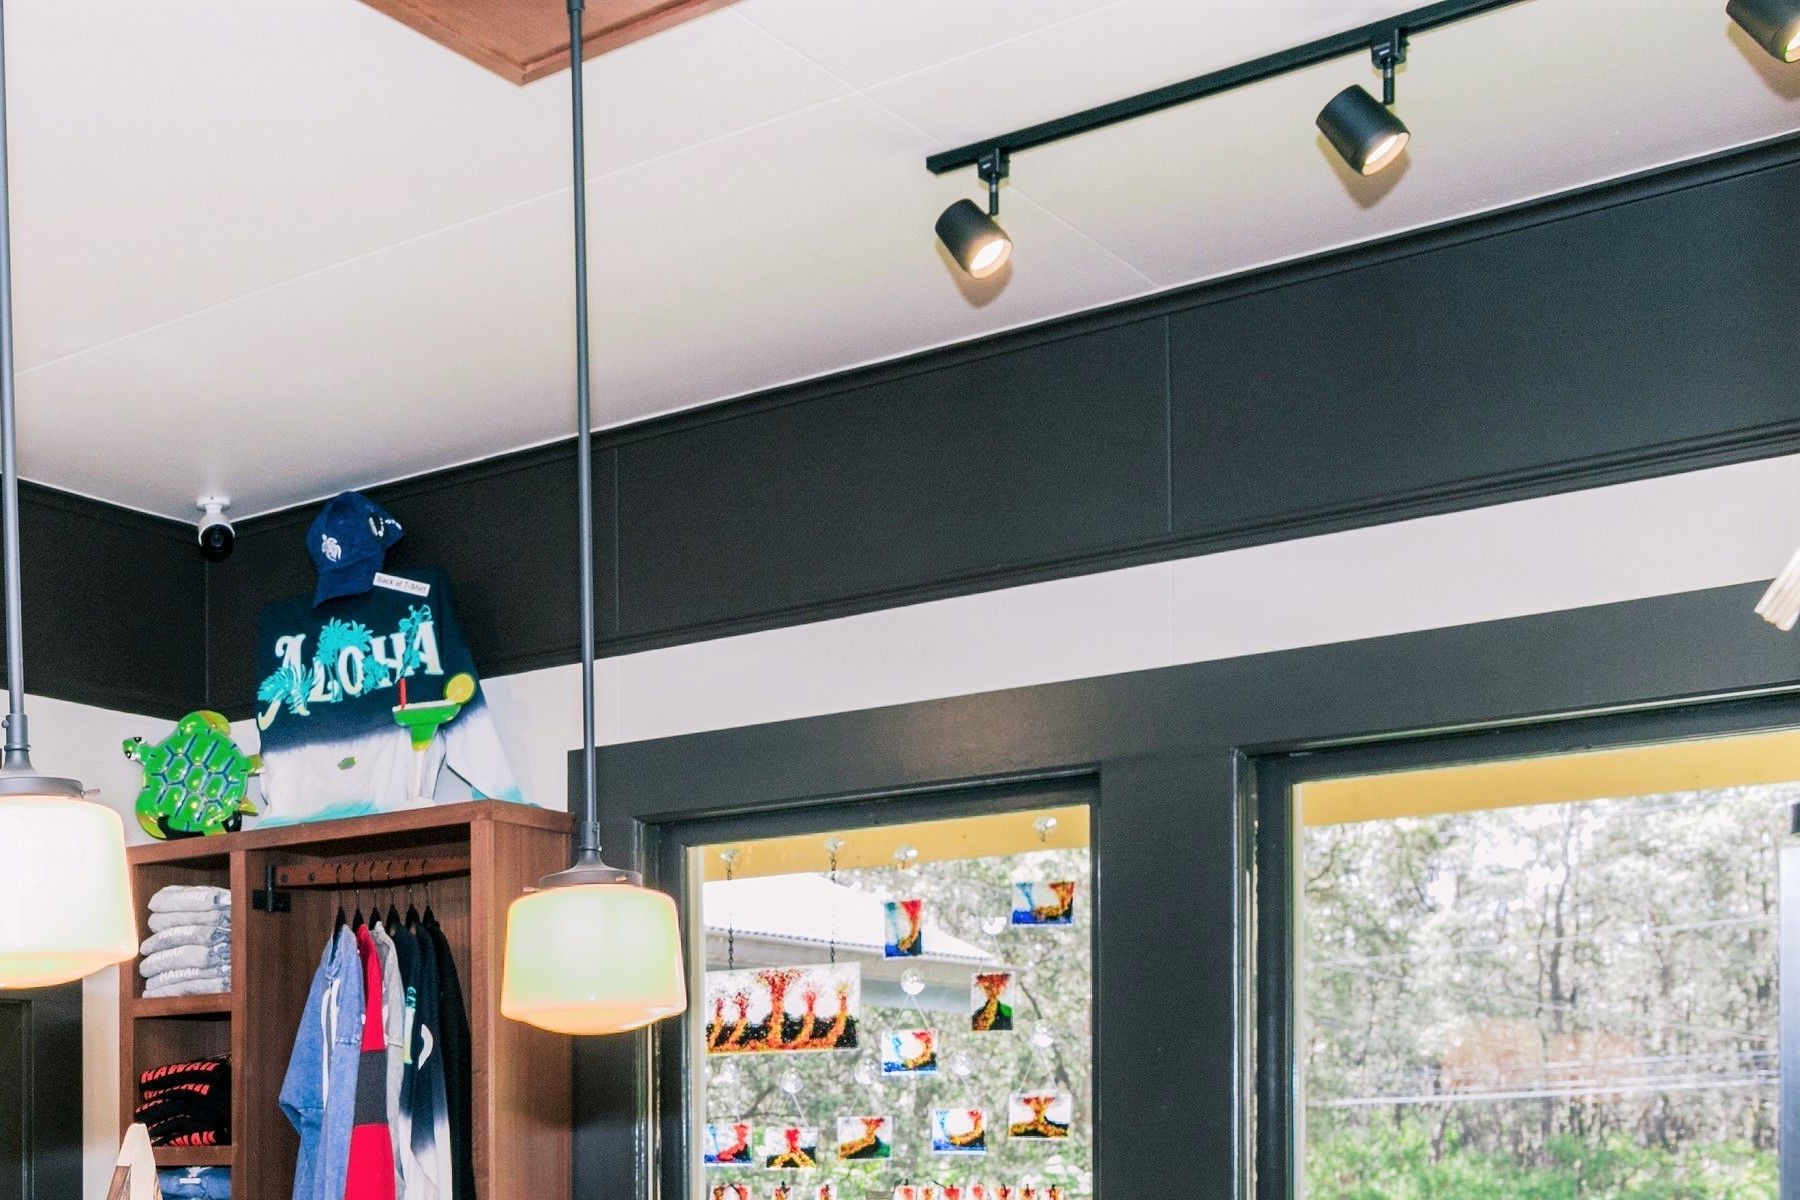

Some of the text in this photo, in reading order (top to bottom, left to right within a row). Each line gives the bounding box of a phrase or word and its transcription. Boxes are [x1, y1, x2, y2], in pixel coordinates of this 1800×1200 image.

[257, 620, 444, 731] ALOHA
[159, 966, 199, 982] HAWAII
[141, 1061, 220, 1084] HAWAII
